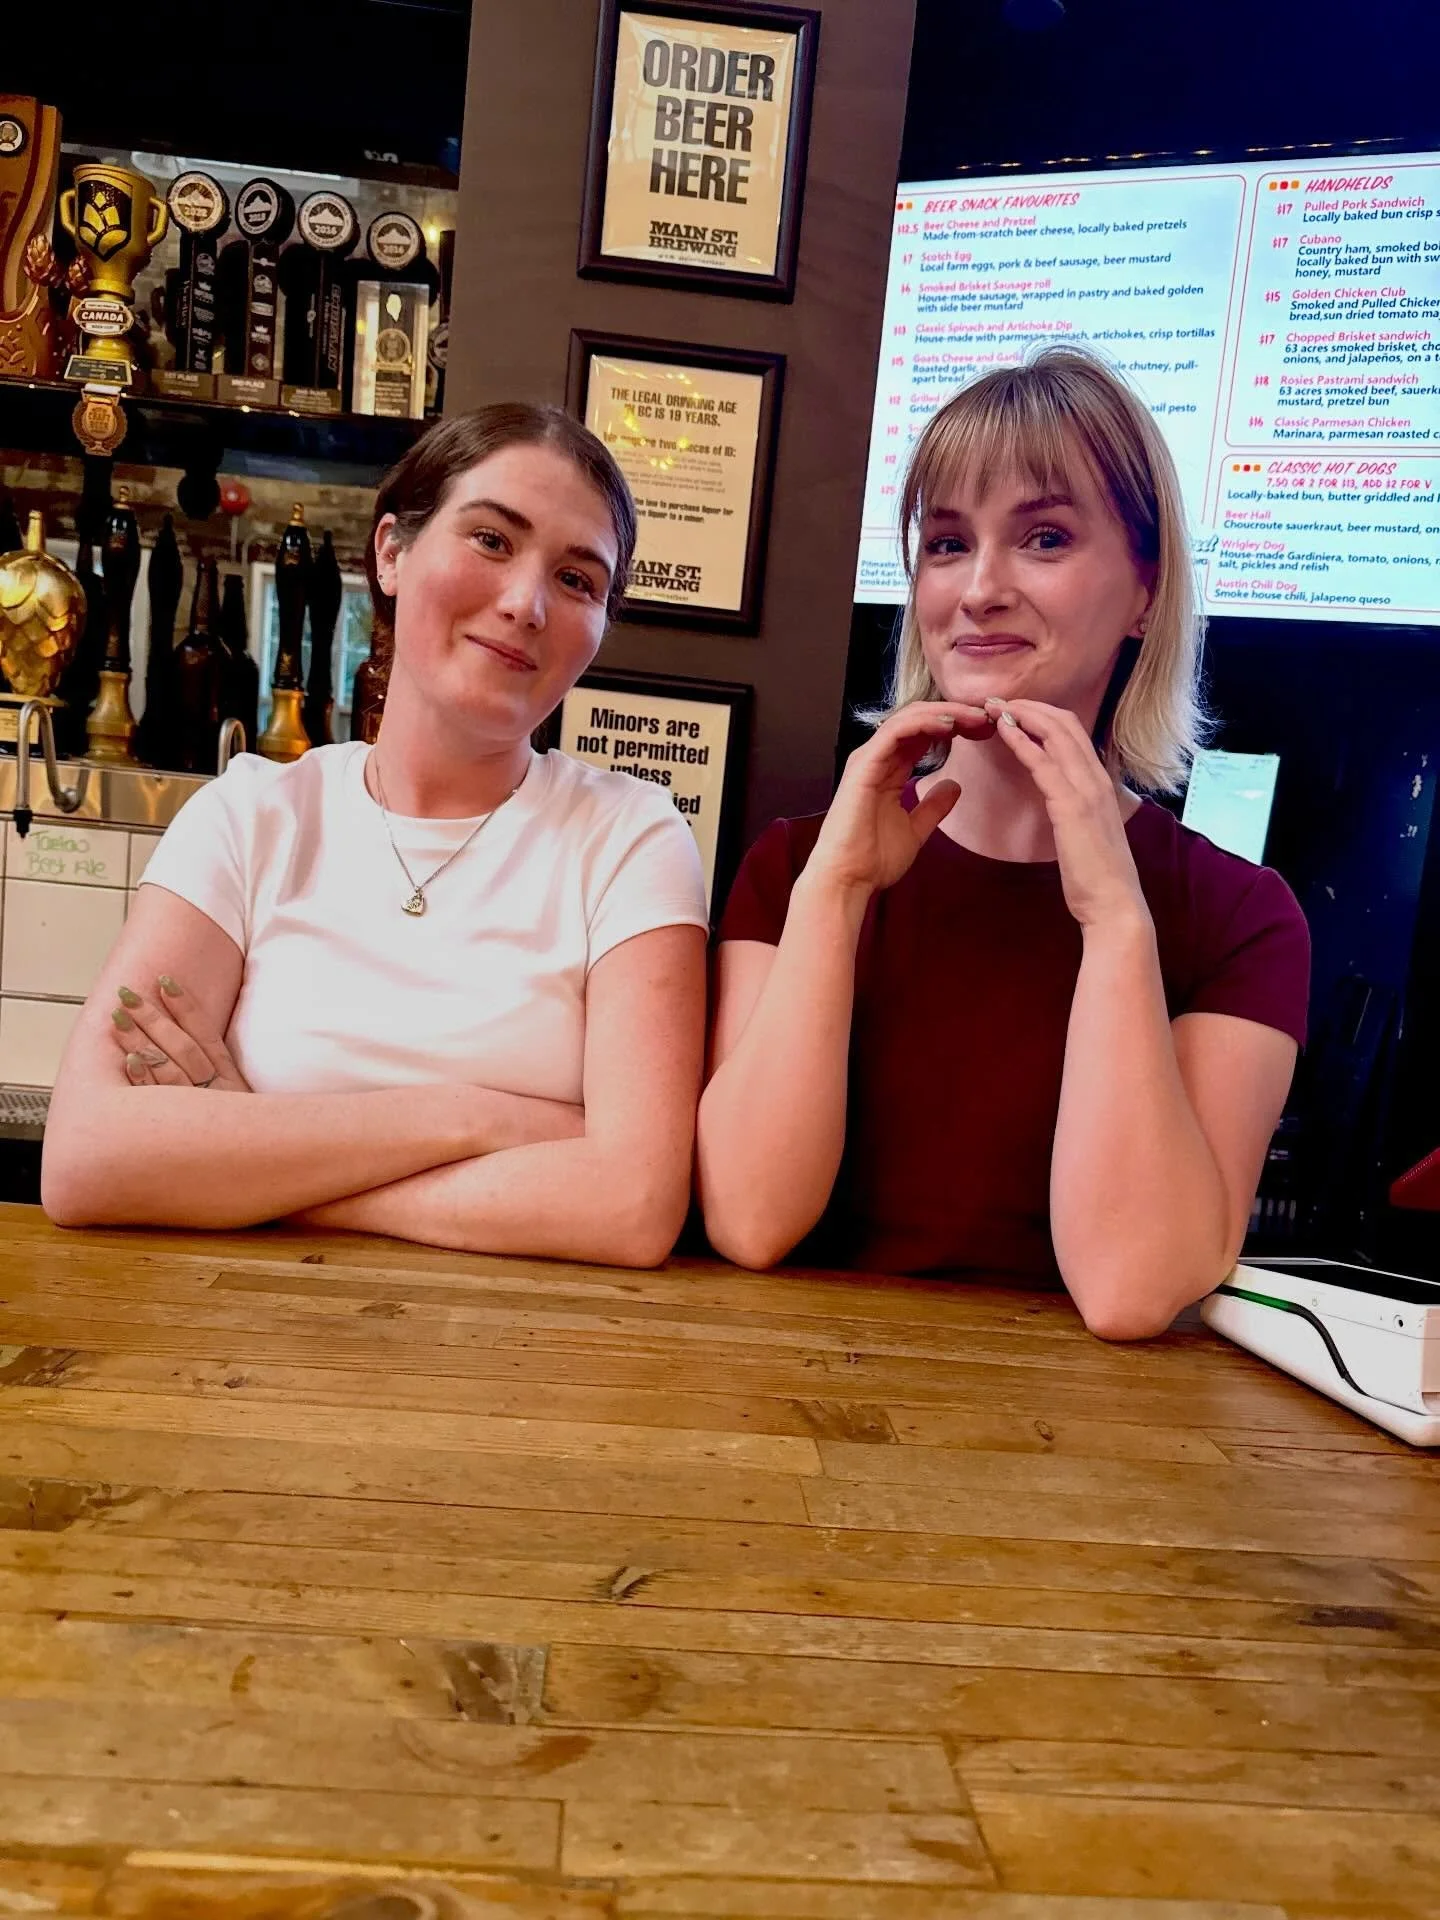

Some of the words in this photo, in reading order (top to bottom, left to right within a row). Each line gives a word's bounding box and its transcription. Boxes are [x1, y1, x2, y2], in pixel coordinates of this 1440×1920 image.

[643, 39, 776, 101] ORDER
[654, 94, 754, 152] BEER
[650, 148, 751, 204] HERE
[1305, 176, 1393, 193] HANDHELDS
[924, 200, 956, 213] BEER
[959, 198, 1001, 211] SNACK
[1004, 192, 1080, 209] FAVOURITES
[1277, 204, 1293, 215] $17
[1304, 201, 1338, 211] Pulled
[1370, 196, 1425, 208] Sandwich
[1303, 212, 1341, 224] Locally
[1344, 210, 1378, 221] baked
[1381, 209, 1403, 219] bun
[1407, 208, 1433, 220] crisp
[924, 221, 944, 231] Beer
[947, 219, 979, 229] Cheese
[1002, 216, 1036, 227] Pretzel
[1016, 226, 1037, 236] beer
[1078, 223, 1110, 235] locally
[1113, 221, 1144, 232] baked
[1147, 219, 1187, 232] pretzels
[648, 220, 708, 241] MAIN
[711, 228, 738, 245] ST.
[648, 235, 736, 258] BREWING
[1273, 238, 1288, 249] $17
[1300, 235, 1342, 244] Cubano
[1298, 246, 1342, 257] Country
[1376, 242, 1420, 252] smoked
[920, 252, 950, 262] Scotch
[920, 263, 944, 272] Local
[946, 262, 968, 270] farm
[971, 261, 995, 271] eggs,
[999, 260, 1020, 271] pork
[1059, 257, 1100, 268] sausage,
[1103, 255, 1126, 265] beer
[1129, 252, 1171, 264] mustard
[1297, 256, 1332, 268] locally
[1335, 255, 1368, 265] baked
[1372, 254, 1393, 264] bun
[1397, 253, 1421, 263] with
[1295, 268, 1331, 279] honey,
[1335, 266, 1381, 276] mustard
[918, 282, 957, 293] Smoked
[959, 281, 990, 291] Brisket
[993, 280, 1032, 290] Sausage
[1034, 279, 1051, 288] roll
[980, 292, 1018, 302] sausage,
[1022, 287, 1064, 301] wrapped
[1079, 288, 1110, 300] pastry
[1112, 287, 1131, 297] and
[1134, 286, 1165, 296] baked
[1168, 284, 1204, 298] golden
[1292, 289, 1331, 299] Golden
[1335, 288, 1378, 298] Chicken
[1381, 287, 1406, 297] Club
[917, 303, 937, 313] with
[961, 302, 981, 311] beer
[984, 302, 1023, 310] mustard
[1290, 300, 1335, 310] Smoked
[1338, 298, 1358, 308] and
[1362, 298, 1397, 308] Pulled
[82, 312, 123, 322] CANADA
[1345, 308, 1374, 320] dried
[1378, 309, 1418, 318] tomato
[915, 324, 945, 333] Classic
[948, 324, 984, 335] Spinach
[1056, 321, 1072, 331] Dip
[976, 332, 996, 342] with
[1093, 329, 1146, 340] artichokes,
[1149, 329, 1173, 340] crisp
[1176, 328, 1215, 338] tortillas
[1286, 332, 1335, 344] Chopped
[1338, 331, 1376, 341] Brisket
[1378, 330, 1431, 341] sandwich
[1301, 344, 1328, 352] acres
[1331, 343, 1374, 352] smoked
[942, 354, 974, 362] Cheese
[1325, 353, 1345, 363] and
[912, 364, 949, 372] Roasted
[1129, 360, 1171, 372] chutney,
[1175, 360, 1198, 372] pull-
[1280, 376, 1313, 385] Rosies
[1317, 374, 1364, 384] Pastrami
[1367, 374, 1419, 384] sandwich
[1295, 386, 1322, 395] acres
[1325, 385, 1367, 395] smoked
[611, 387, 629, 400] THE
[633, 390, 662, 405] LEGAL
[666, 394, 714, 411] DRINKING
[718, 400, 737, 414] AGE
[1368, 397, 1390, 406] bun
[638, 405, 652, 418] BC
[655, 407, 665, 419] IS
[670, 410, 681, 421] 19
[685, 411, 720, 426] YEARS.
[1168, 403, 1196, 415] pesto
[1274, 417, 1310, 427] Classic
[1312, 417, 1364, 427] Parmesan
[1367, 416, 1411, 427] Chicken
[1329, 429, 1383, 440] parmesan
[1387, 429, 1431, 439] roasted
[659, 439, 676, 449] two
[679, 443, 710, 453] eces
[713, 445, 721, 456] of
[1267, 462, 1321, 474] CLASSIC
[1325, 463, 1353, 474] HOT
[1356, 462, 1397, 475] DOGS
[1327, 492, 1361, 501] butter
[1364, 493, 1410, 504] griddled
[668, 503, 699, 512] purchase
[1225, 510, 1248, 519] Beer
[1251, 511, 1271, 520] Hall
[1223, 520, 1283, 530] Choucroute
[1221, 539, 1260, 550] Wrigley
[1263, 541, 1285, 551] Dog
[675, 564, 702, 580] ST.
[1241, 561, 1276, 572] pickles
[1301, 562, 1329, 572] relish
[629, 575, 700, 592] REWING
[1216, 579, 1249, 589] Austin
[1251, 580, 1273, 589] Chili
[1276, 581, 1298, 592] Dog
[1215, 589, 1249, 599] Smoke
[1252, 590, 1282, 601] house
[1310, 592, 1356, 604] jalapeno
[1359, 595, 1391, 606] queso
[590, 708, 660, 734] Minors
[666, 720, 700, 739] are
[577, 735, 608, 754] not
[614, 737, 709, 765] permitted
